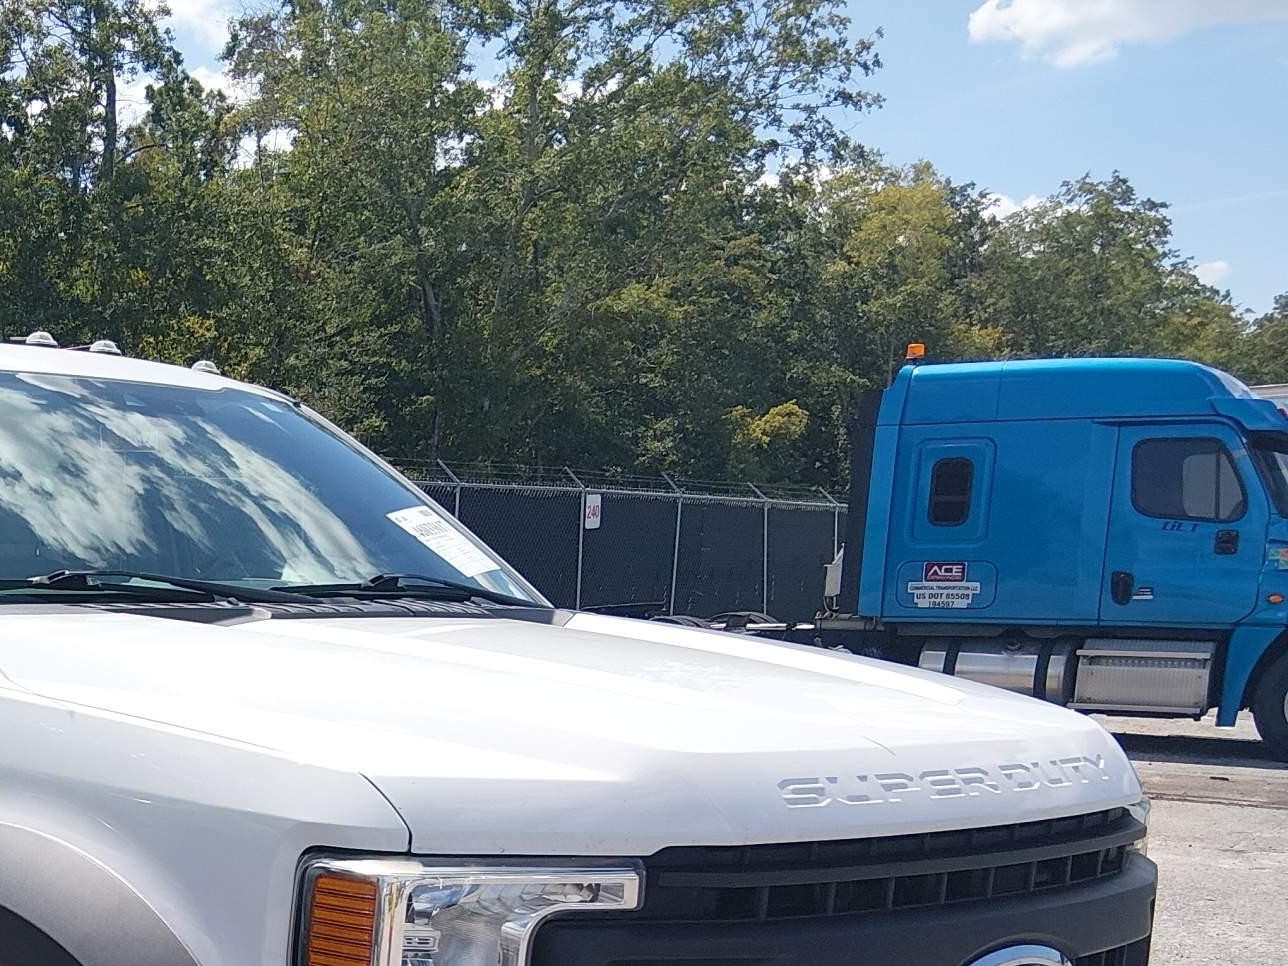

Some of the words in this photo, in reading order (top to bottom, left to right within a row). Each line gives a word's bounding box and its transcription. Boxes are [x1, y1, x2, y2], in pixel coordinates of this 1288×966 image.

[587, 504, 600, 519] 240
[927, 565, 963, 576] ACE
[916, 592, 926, 600] US
[928, 592, 944, 600] DOT
[776, 767, 1002, 809] SUPER
[998, 753, 1109, 793] DUTY
